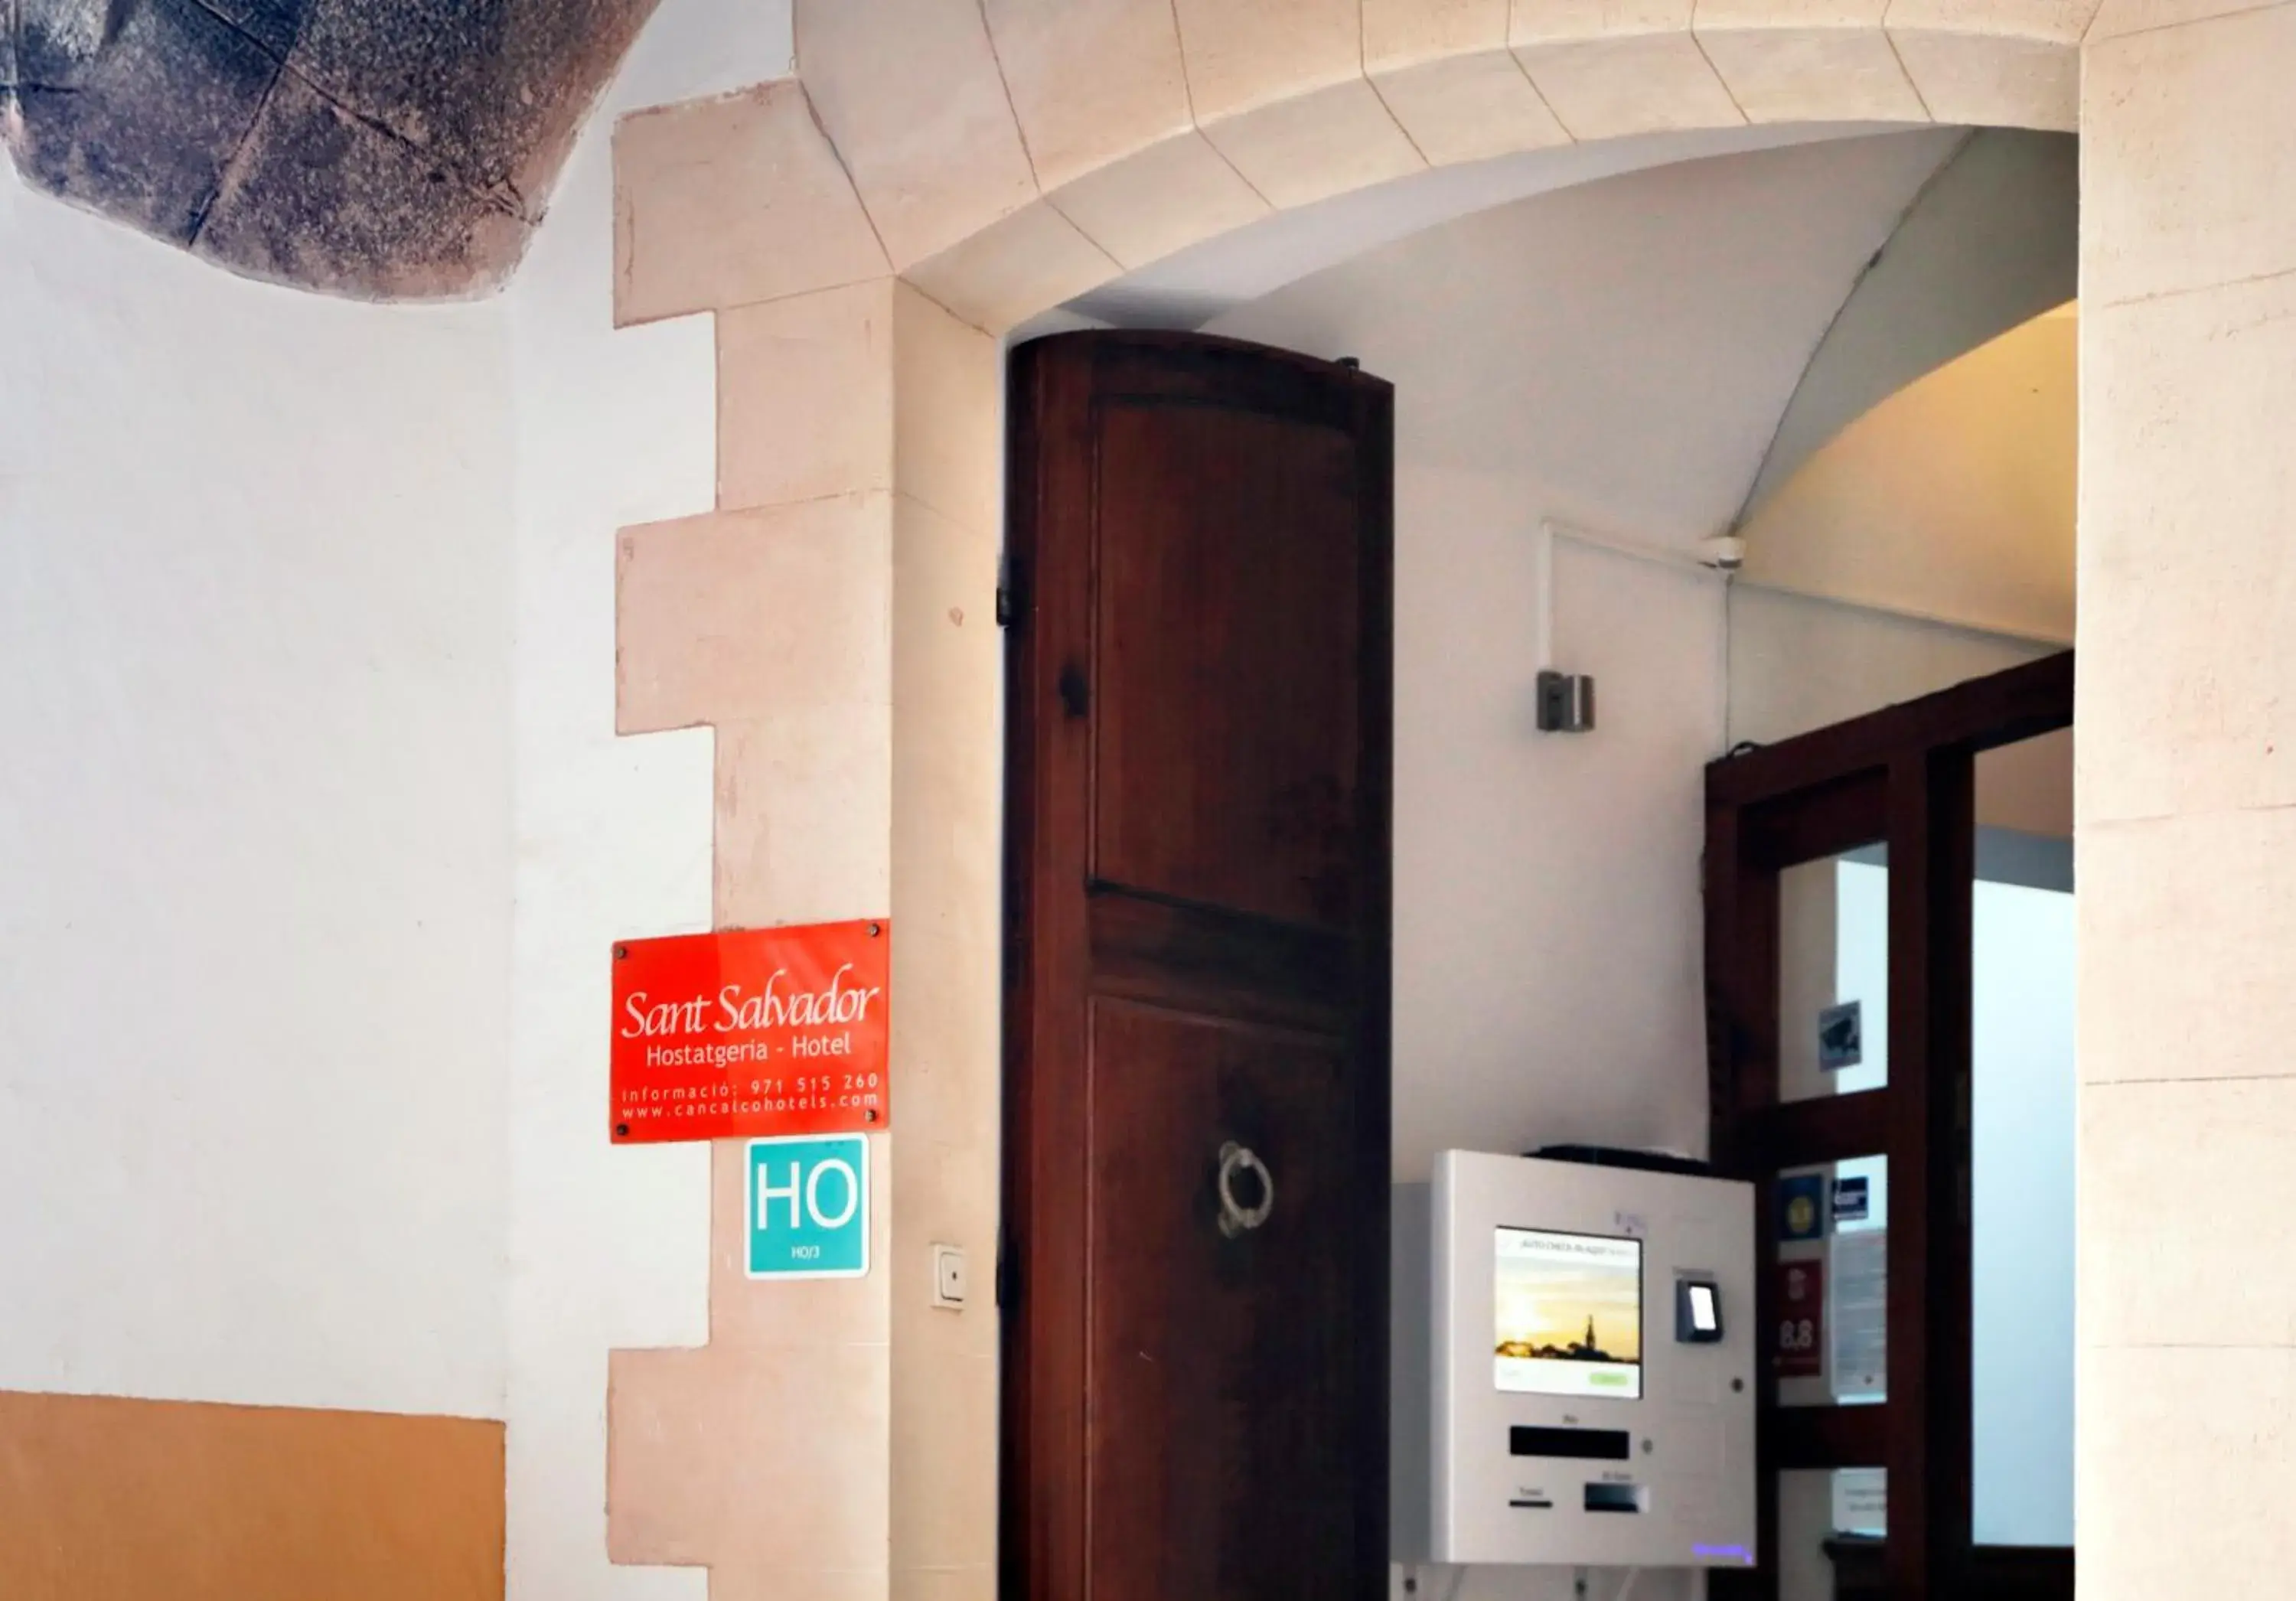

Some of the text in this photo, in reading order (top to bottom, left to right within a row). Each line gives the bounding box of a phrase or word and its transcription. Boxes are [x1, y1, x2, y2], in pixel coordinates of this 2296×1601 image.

[621, 962, 879, 1039] Sant Salvador
[647, 1039, 768, 1068] Hostatgeria
[792, 1032, 851, 1059] Hotel
[751, 1078, 782, 1095] 971
[797, 1075, 830, 1093] 515
[844, 1071, 878, 1090] 260
[622, 1093, 878, 1118] www.cancalcohotels.com
[758, 1159, 858, 1229] HO
